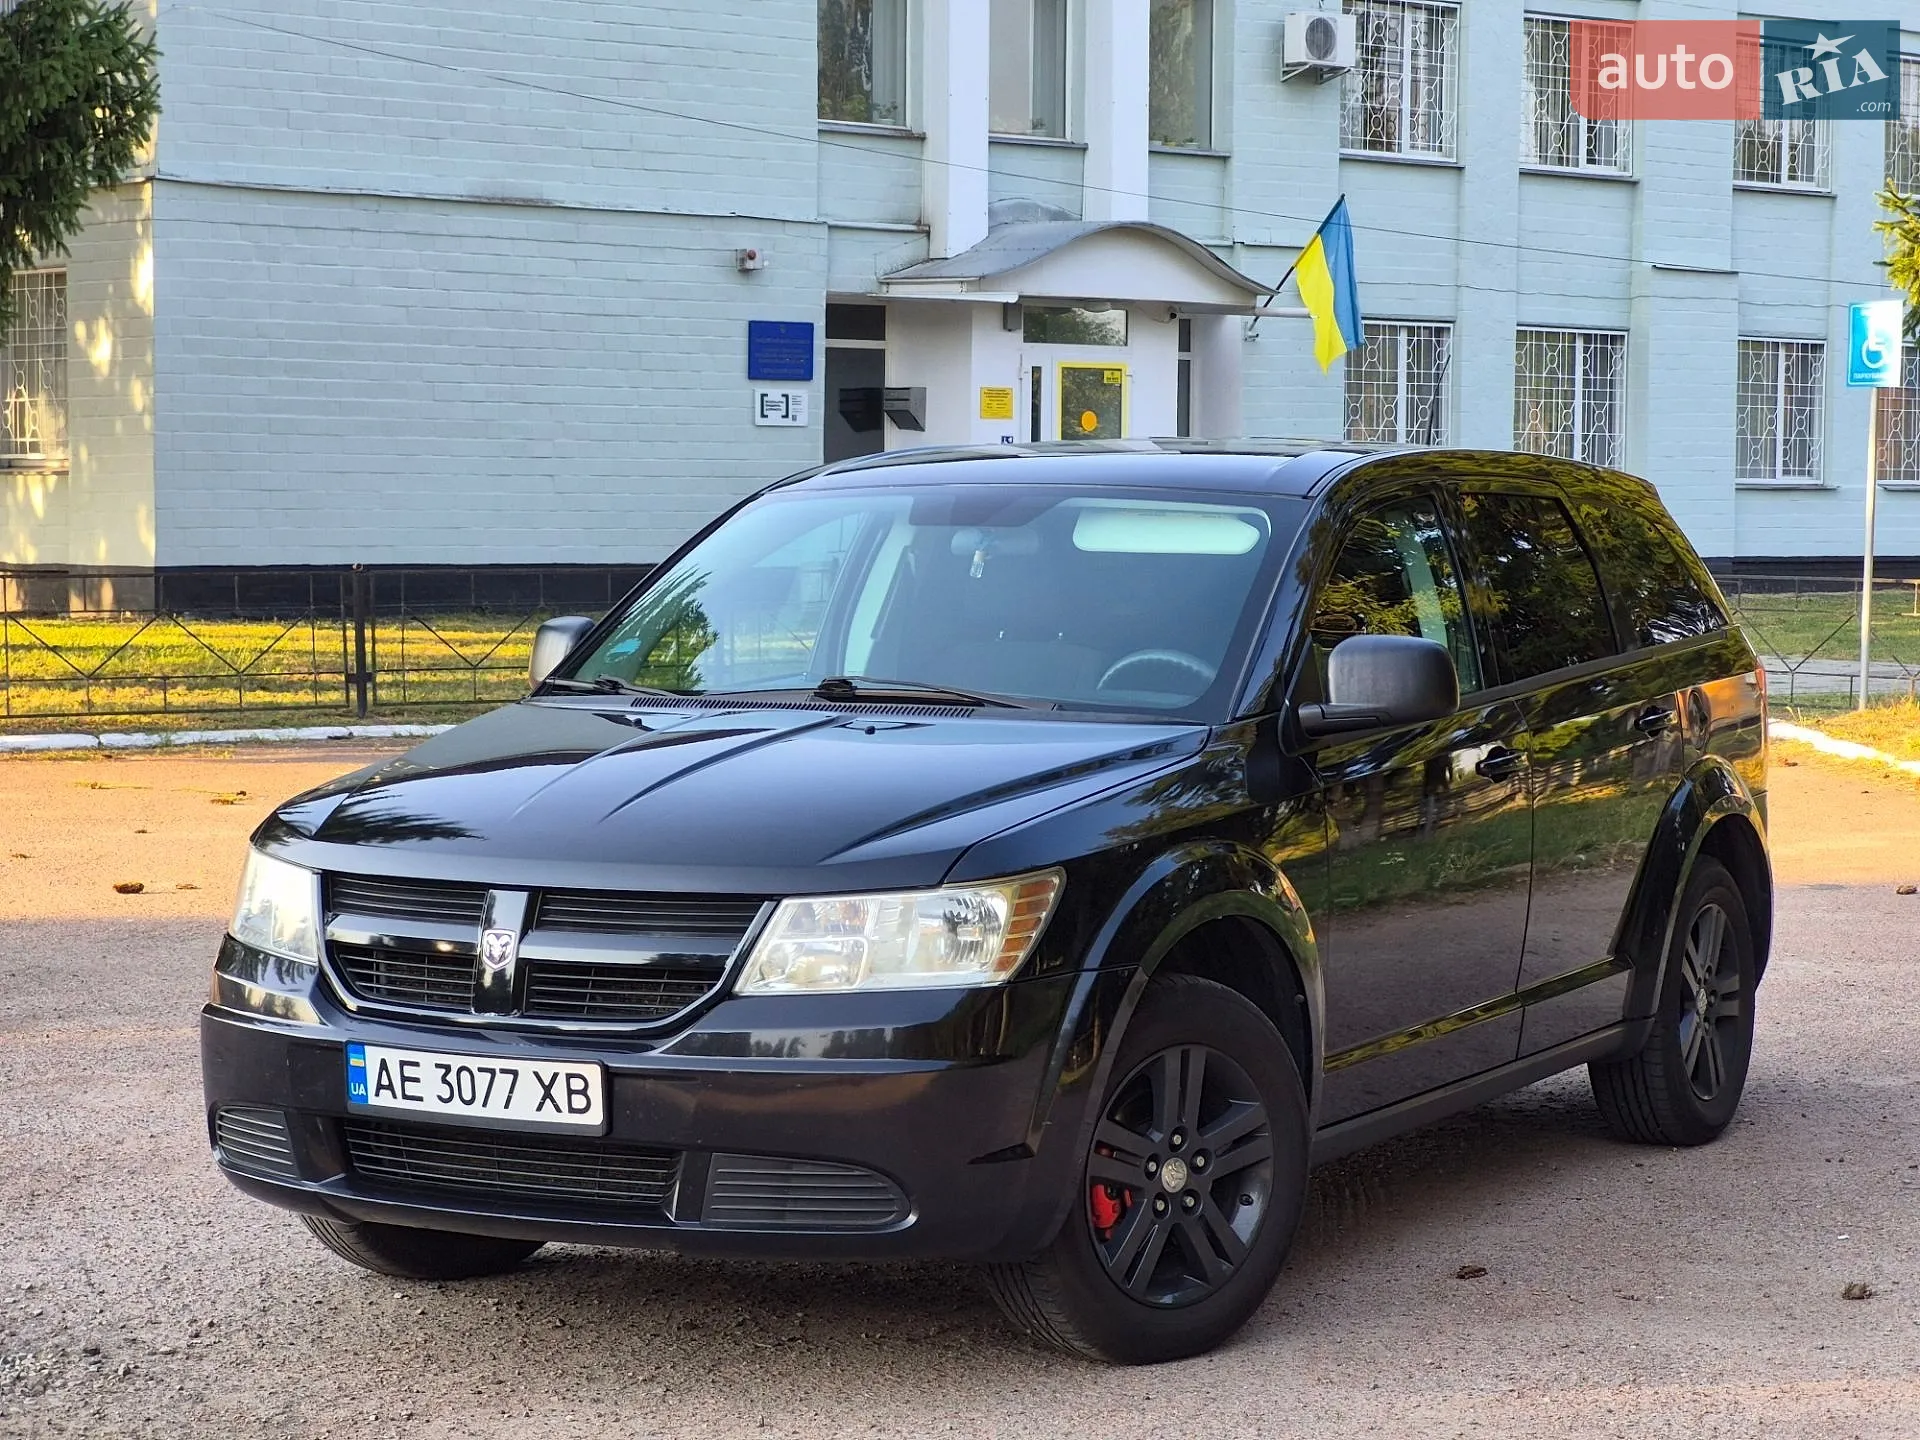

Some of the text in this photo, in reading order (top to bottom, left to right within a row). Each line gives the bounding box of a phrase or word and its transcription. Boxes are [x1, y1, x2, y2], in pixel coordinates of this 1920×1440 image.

[351, 1083, 367, 1097] UA
[373, 1057, 592, 1115] AE 3077 XB
